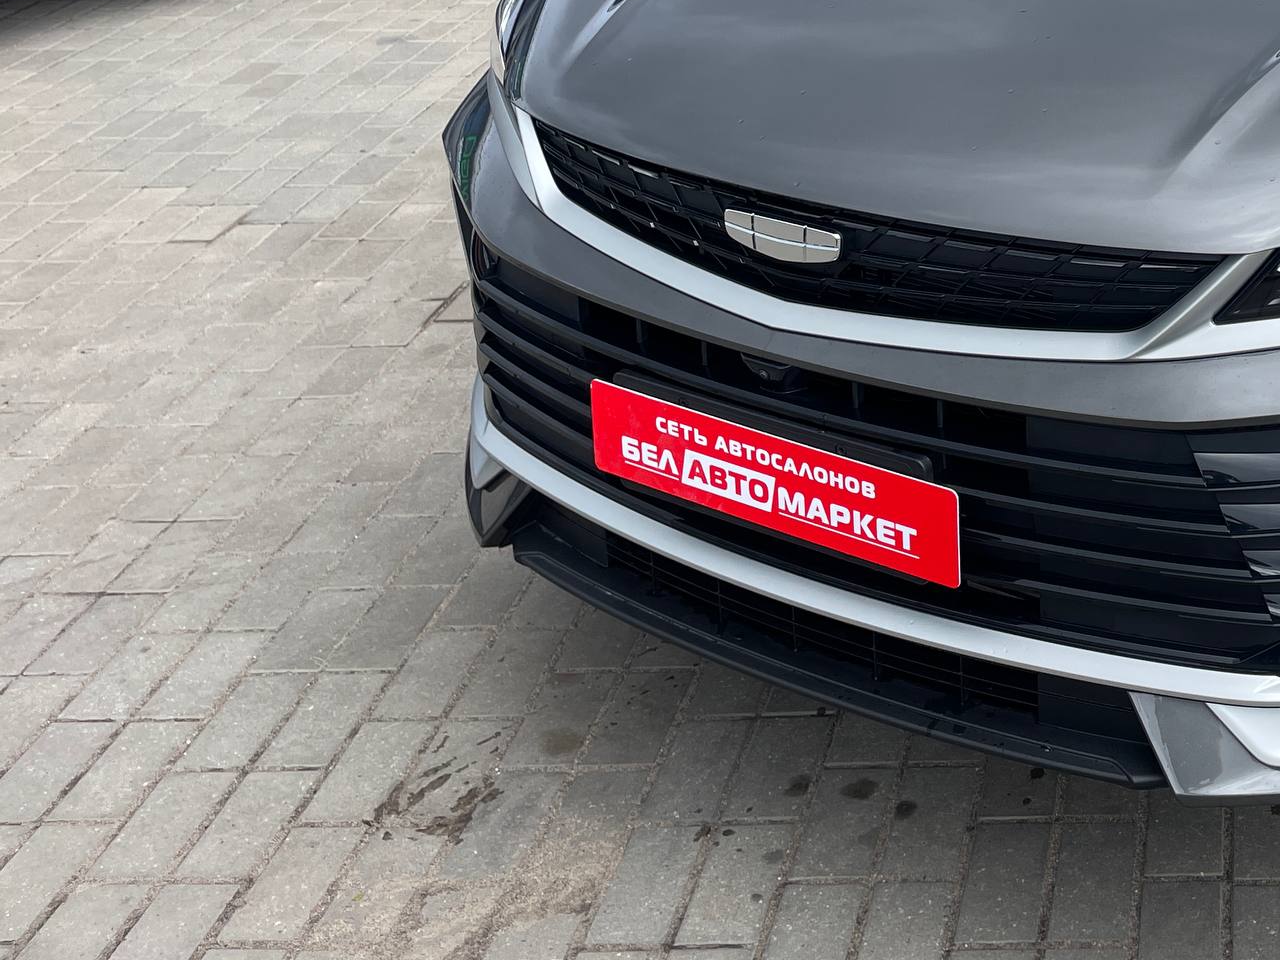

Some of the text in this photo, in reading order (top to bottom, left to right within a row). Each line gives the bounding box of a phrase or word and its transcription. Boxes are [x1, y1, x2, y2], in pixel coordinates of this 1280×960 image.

[620, 435, 918, 551] БЕЛ АВТО МАРКЕТ
[655, 416, 877, 499] СЕТЬ АВТОСАЛОНОВ
